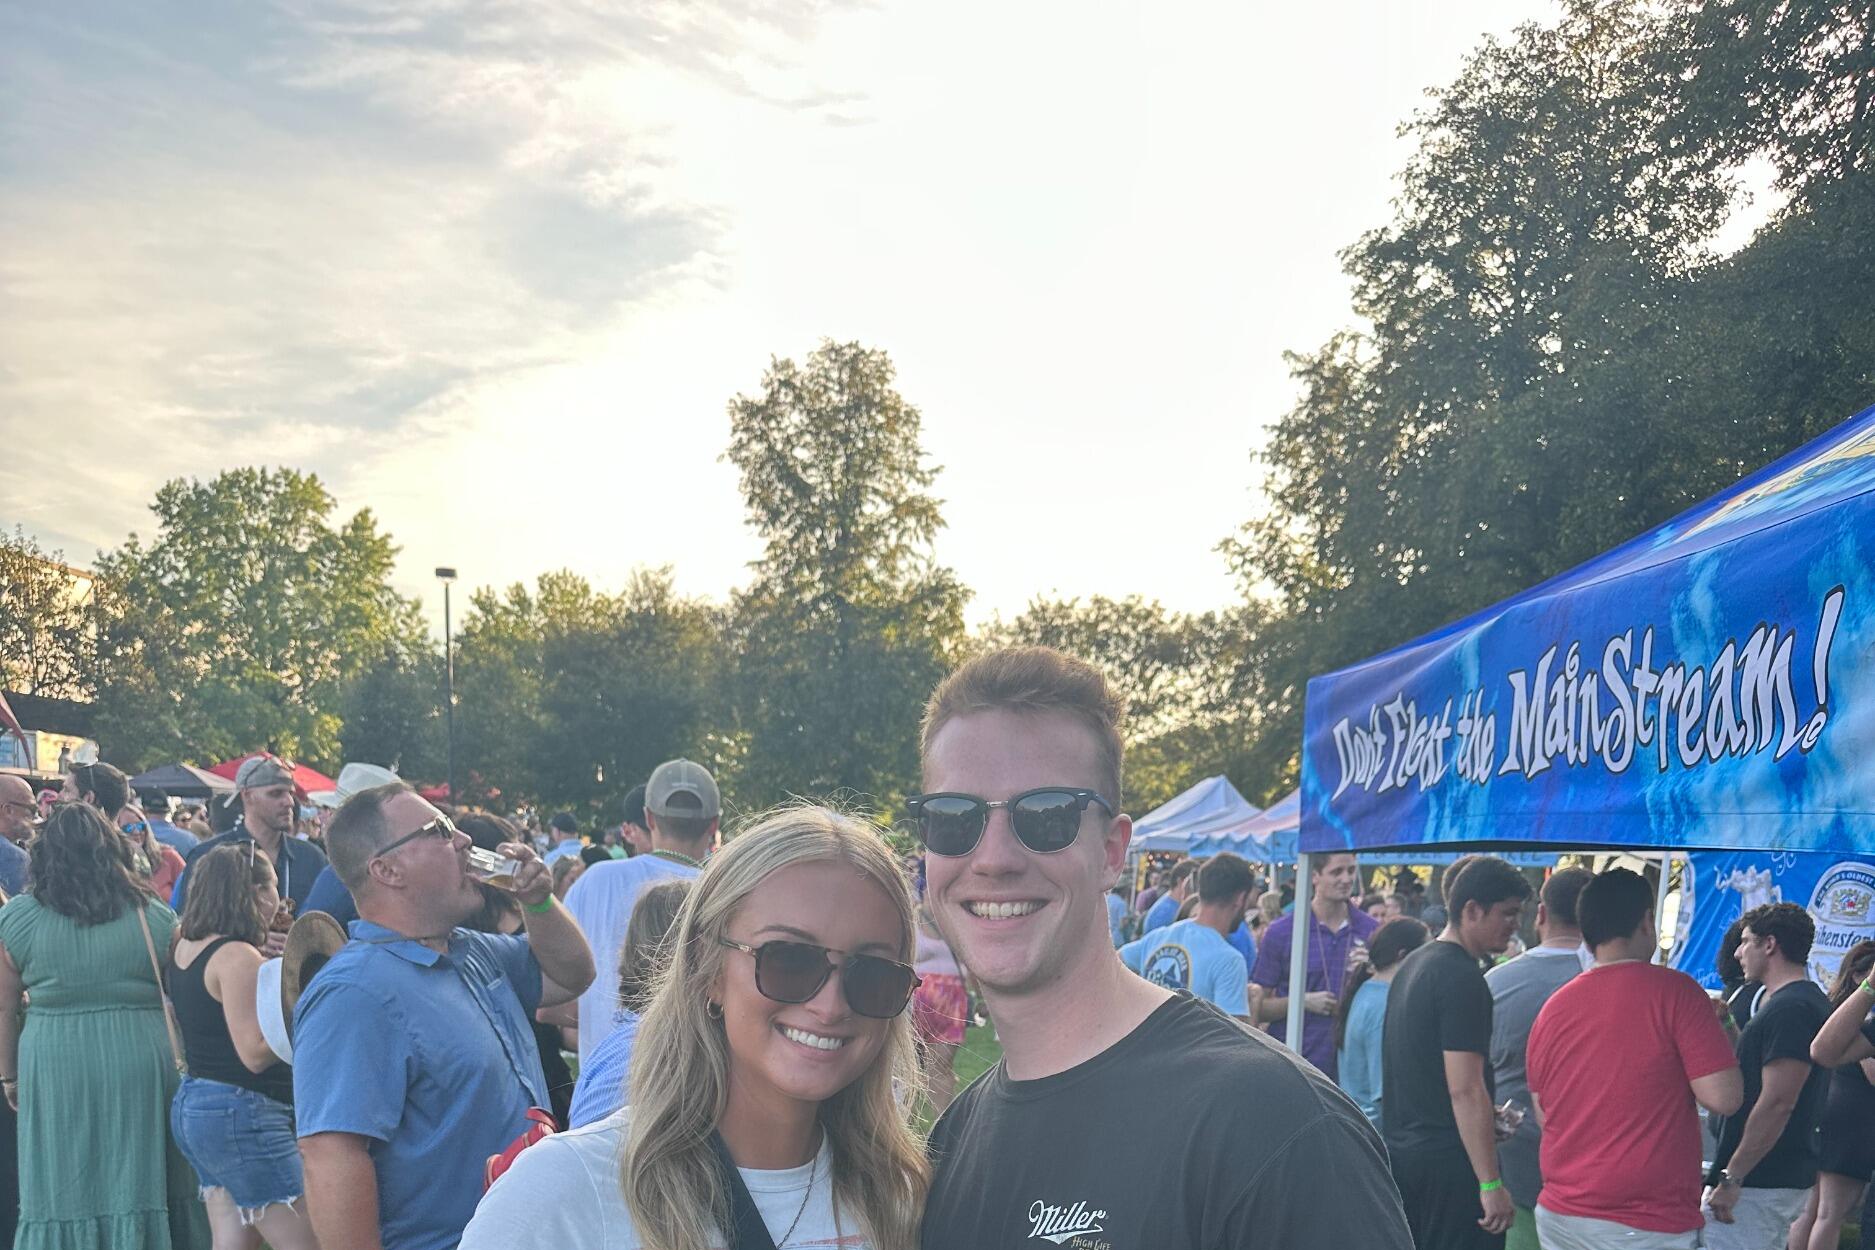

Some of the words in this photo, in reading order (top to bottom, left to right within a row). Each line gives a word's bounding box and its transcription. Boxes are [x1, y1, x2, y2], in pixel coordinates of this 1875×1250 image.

[1331, 703, 1387, 801] Don't
[1377, 691, 1452, 793] Float
[1456, 687, 1495, 784] the
[1027, 1199, 1107, 1239] Miller
[1071, 1236, 1093, 1249] HIGH
